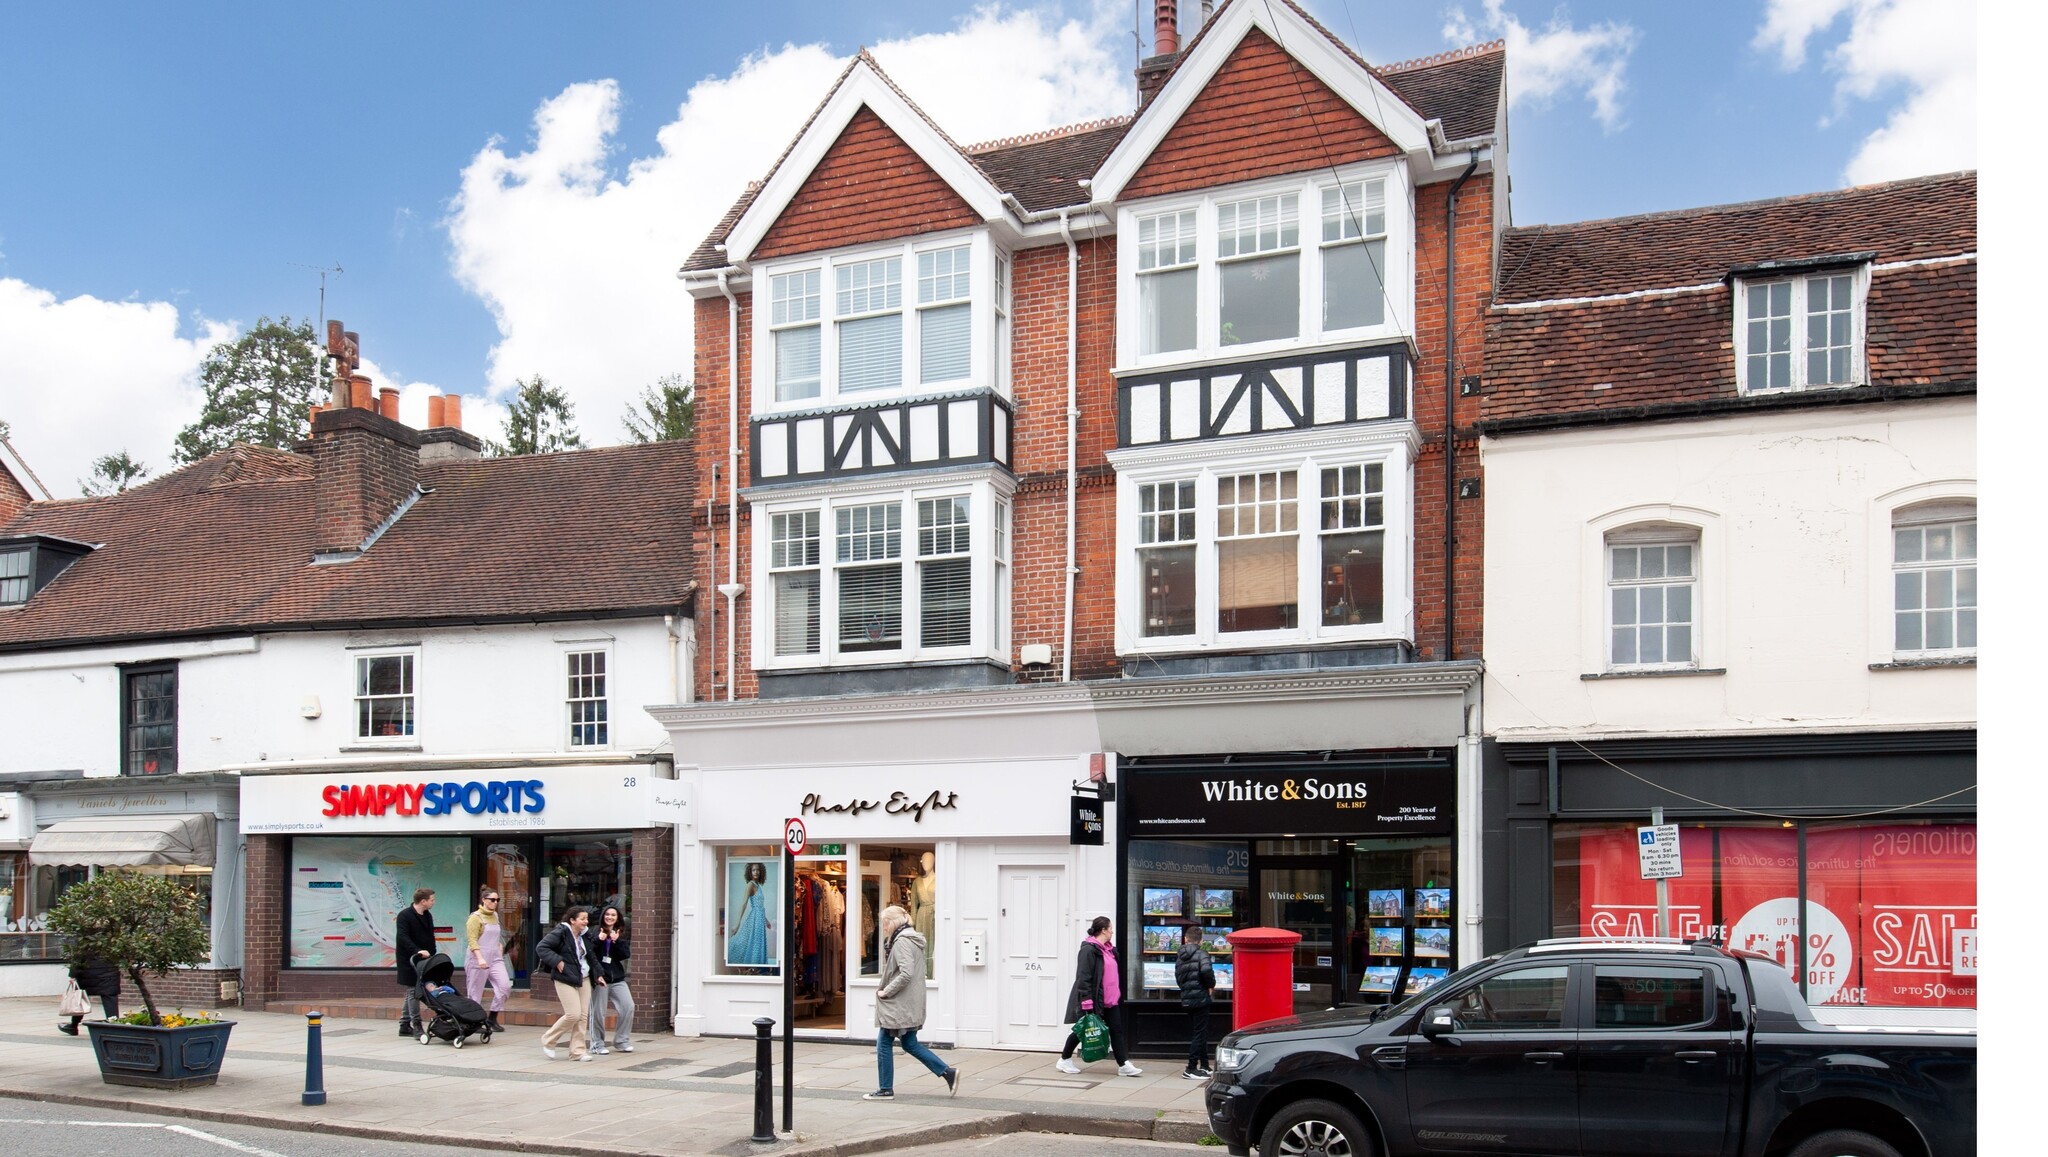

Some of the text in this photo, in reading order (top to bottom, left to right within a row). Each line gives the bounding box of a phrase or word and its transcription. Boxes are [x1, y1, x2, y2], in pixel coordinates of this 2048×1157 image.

[623, 778, 636, 787] 28
[77, 796, 116, 809] Daniels
[119, 794, 167, 811] Jewellers
[800, 790, 959, 823] Phase Eight
[1351, 801, 1367, 809] 1817
[1079, 808, 1097, 821] White
[1377, 815, 1403, 823] Property
[248, 822, 324, 832] www.simplysports.co.uk
[489, 817, 546, 827] Established 1986
[789, 828, 803, 844] 20
[1777, 918, 1788, 926] UP
[1700, 925, 1728, 941] LIFE
[1025, 962, 1042, 971] 26A
[1809, 971, 1836, 985] OFF
[1893, 986, 1908, 995] UP
[1908, 987, 1923, 995] TO
[1957, 987, 1977, 996] OFF
